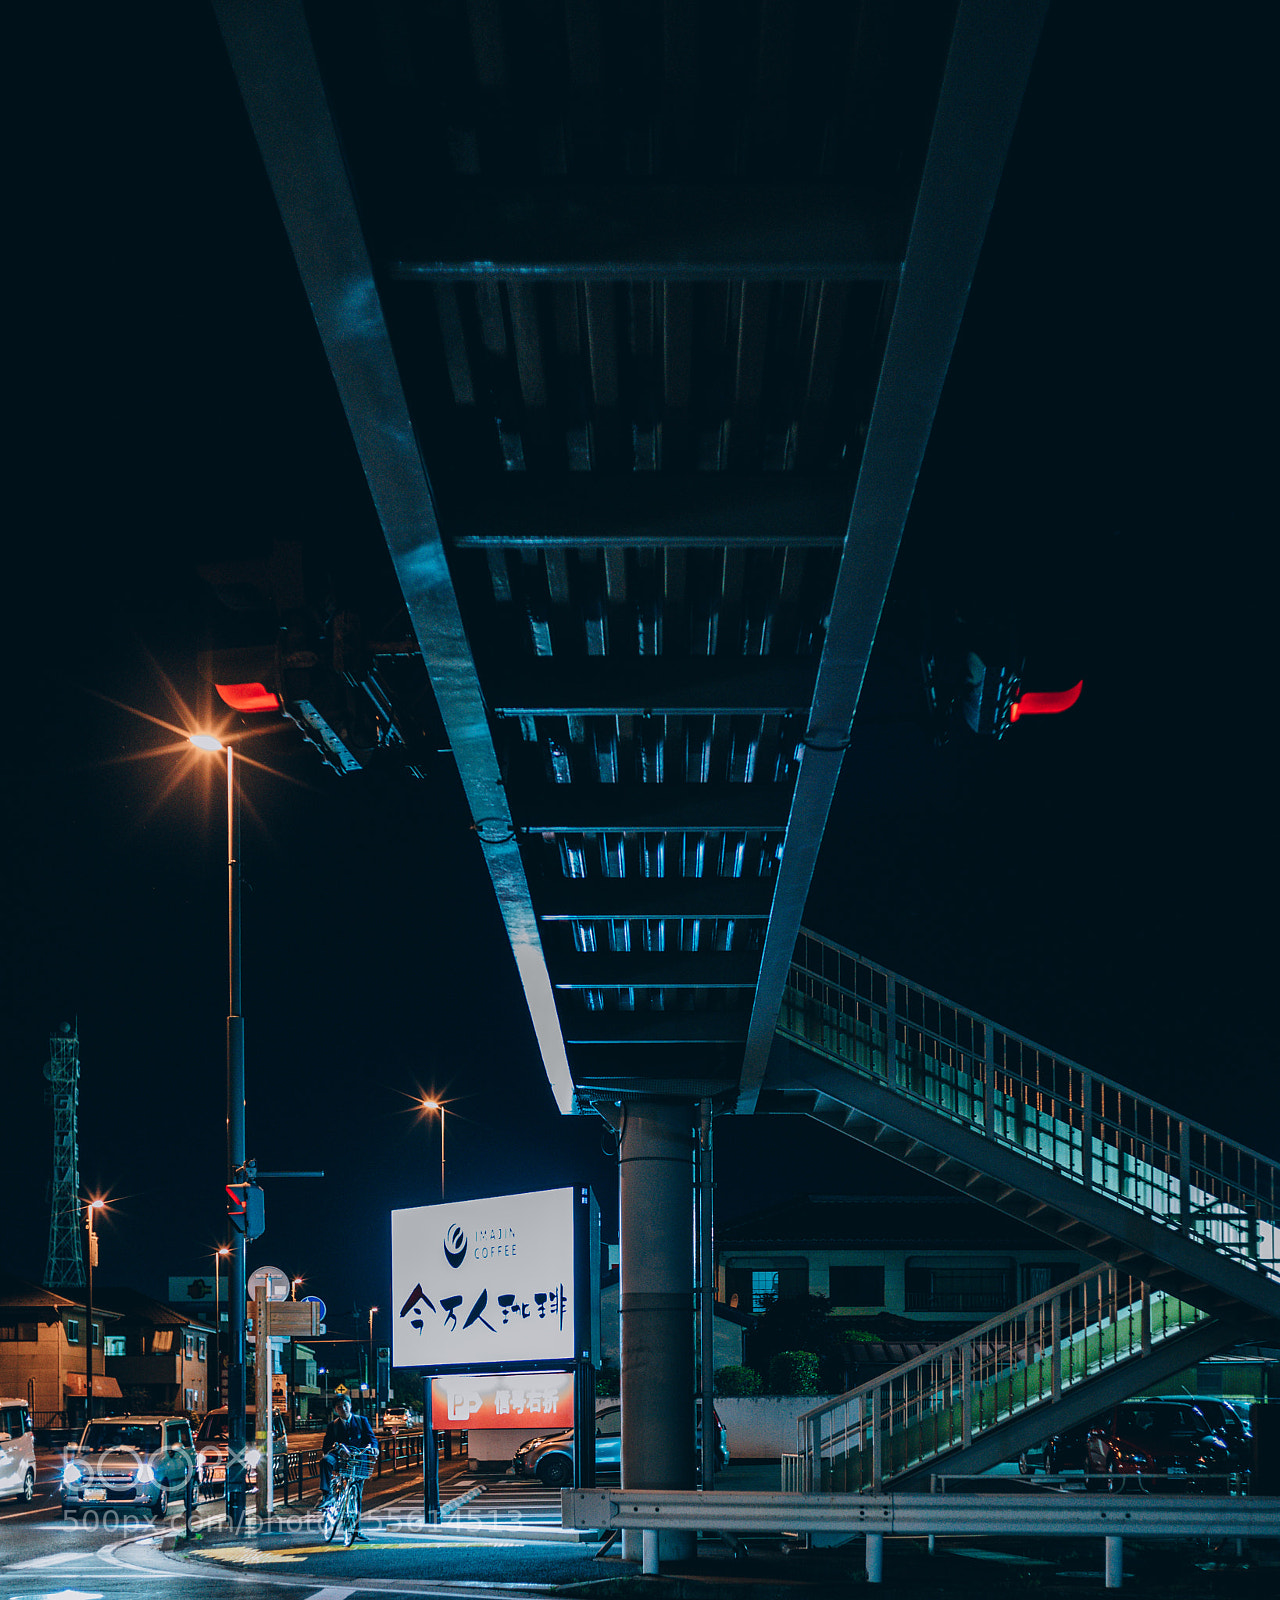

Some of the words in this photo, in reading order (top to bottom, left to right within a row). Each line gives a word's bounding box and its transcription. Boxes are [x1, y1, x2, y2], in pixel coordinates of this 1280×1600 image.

[475, 1228, 516, 1242] IMAJIN
[474, 1244, 517, 1260] COFFEE
[494, 1389, 559, 1415] 信号右折
